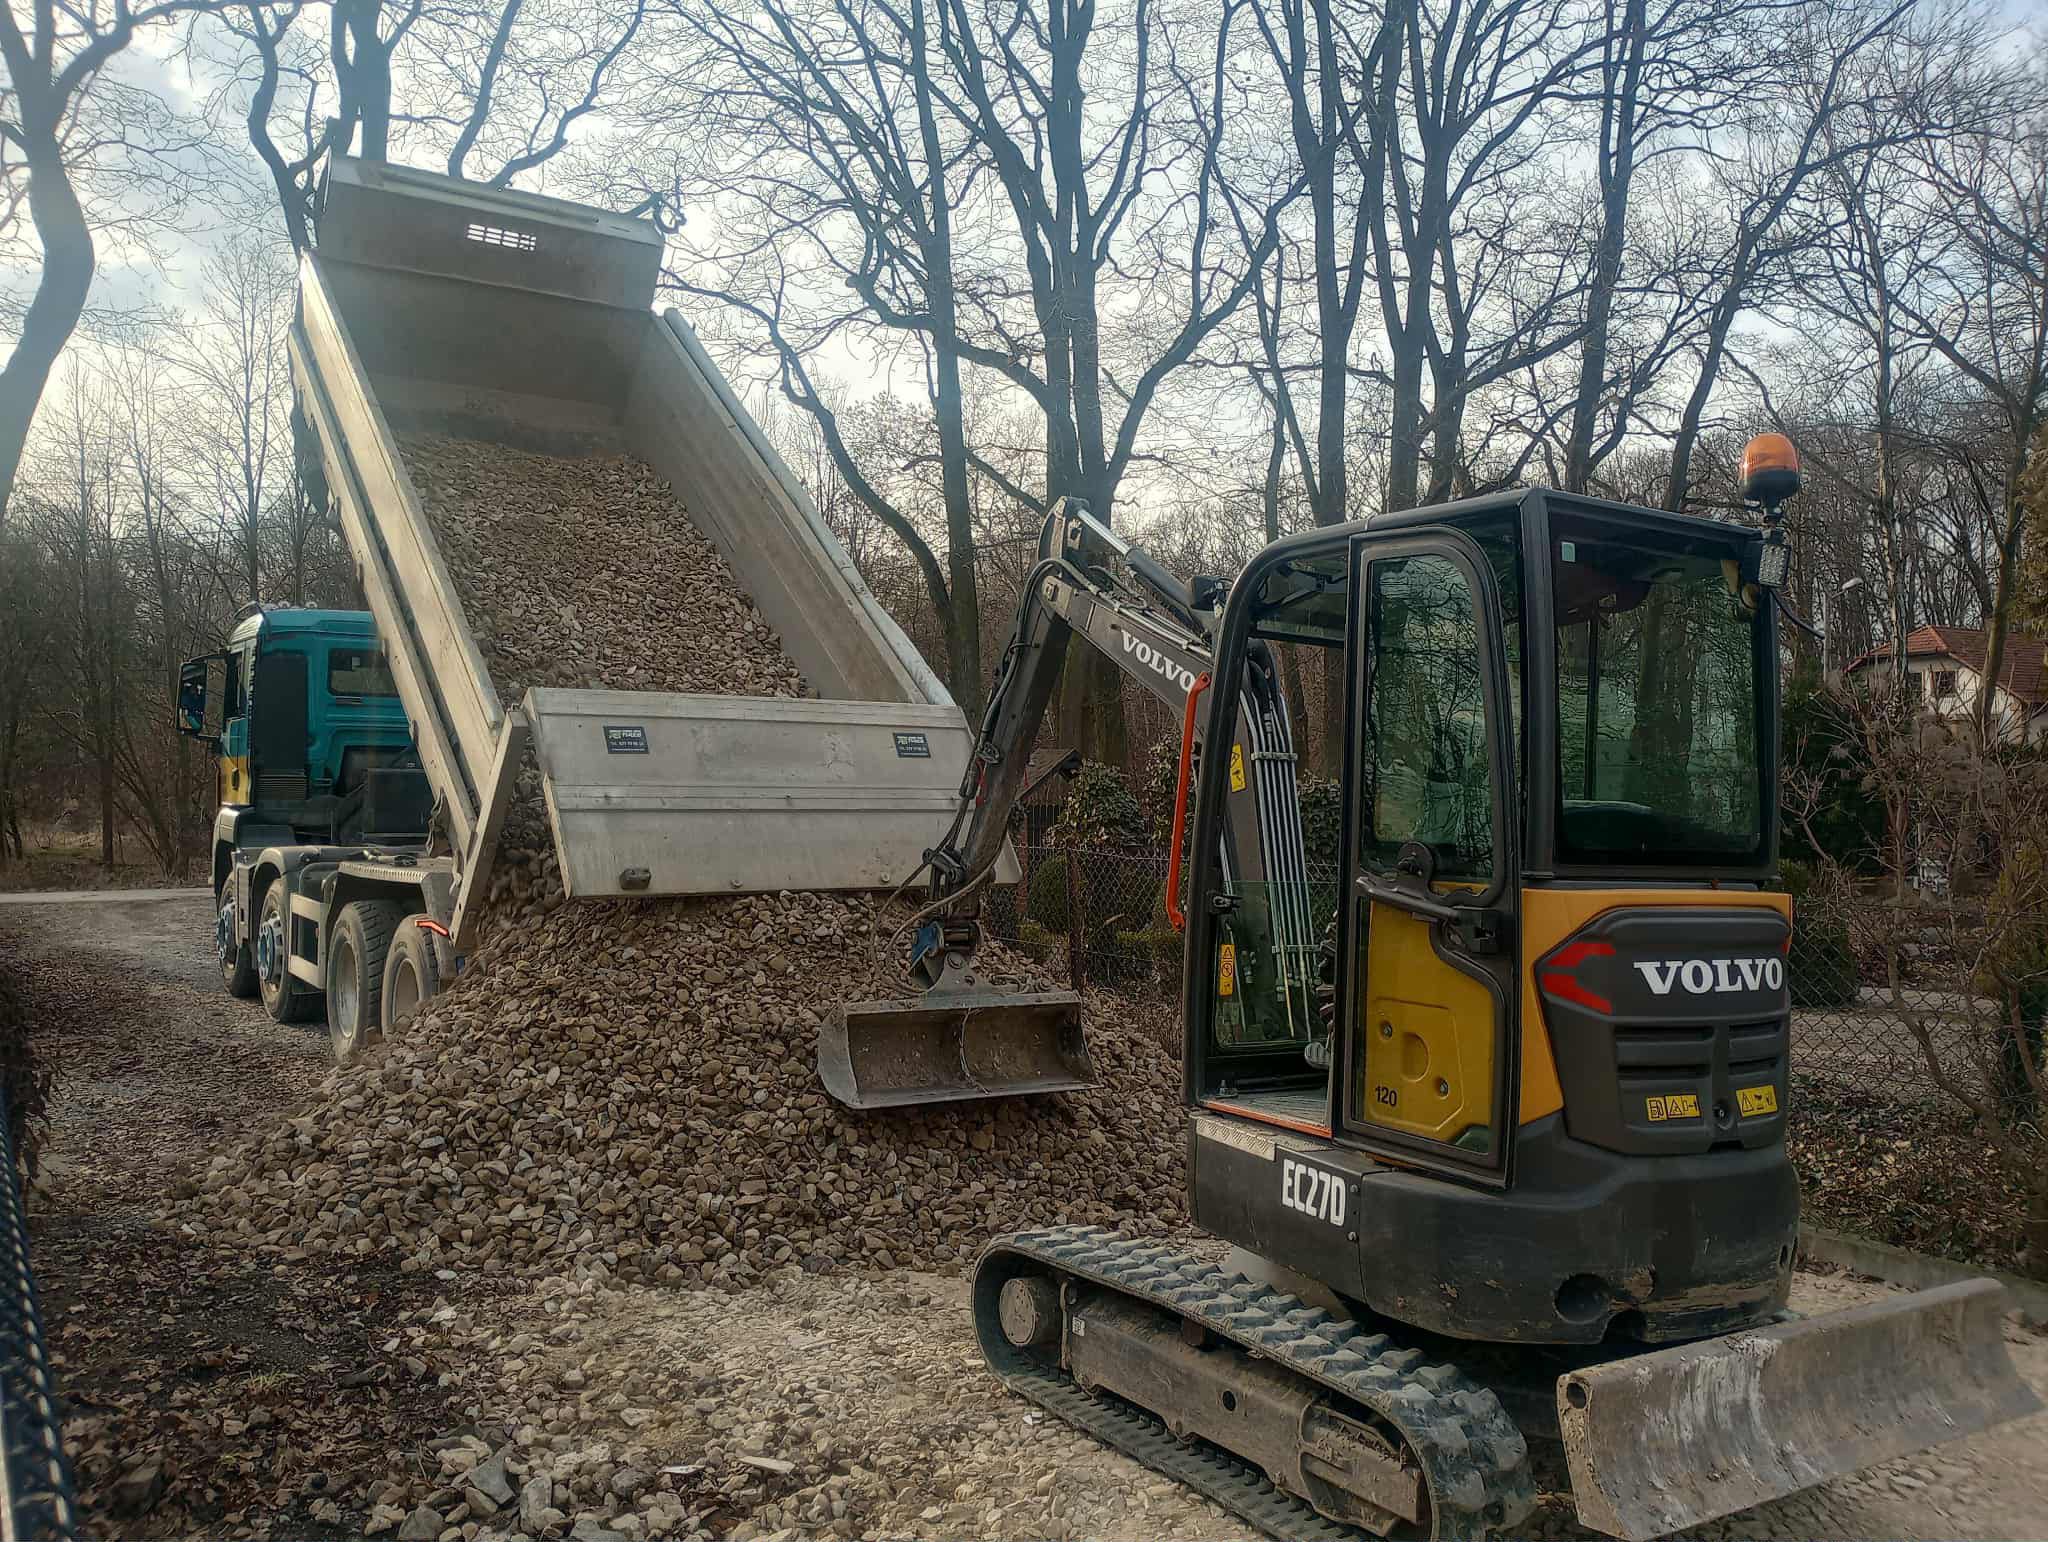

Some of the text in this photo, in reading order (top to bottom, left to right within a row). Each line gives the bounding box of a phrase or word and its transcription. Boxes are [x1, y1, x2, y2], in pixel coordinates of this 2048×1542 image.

[1120, 629, 1196, 692] VOLVO
[1633, 957, 1784, 995] VOLVO
[1375, 1086, 1398, 1108] 120
[1282, 1158, 1346, 1227] EC27D
